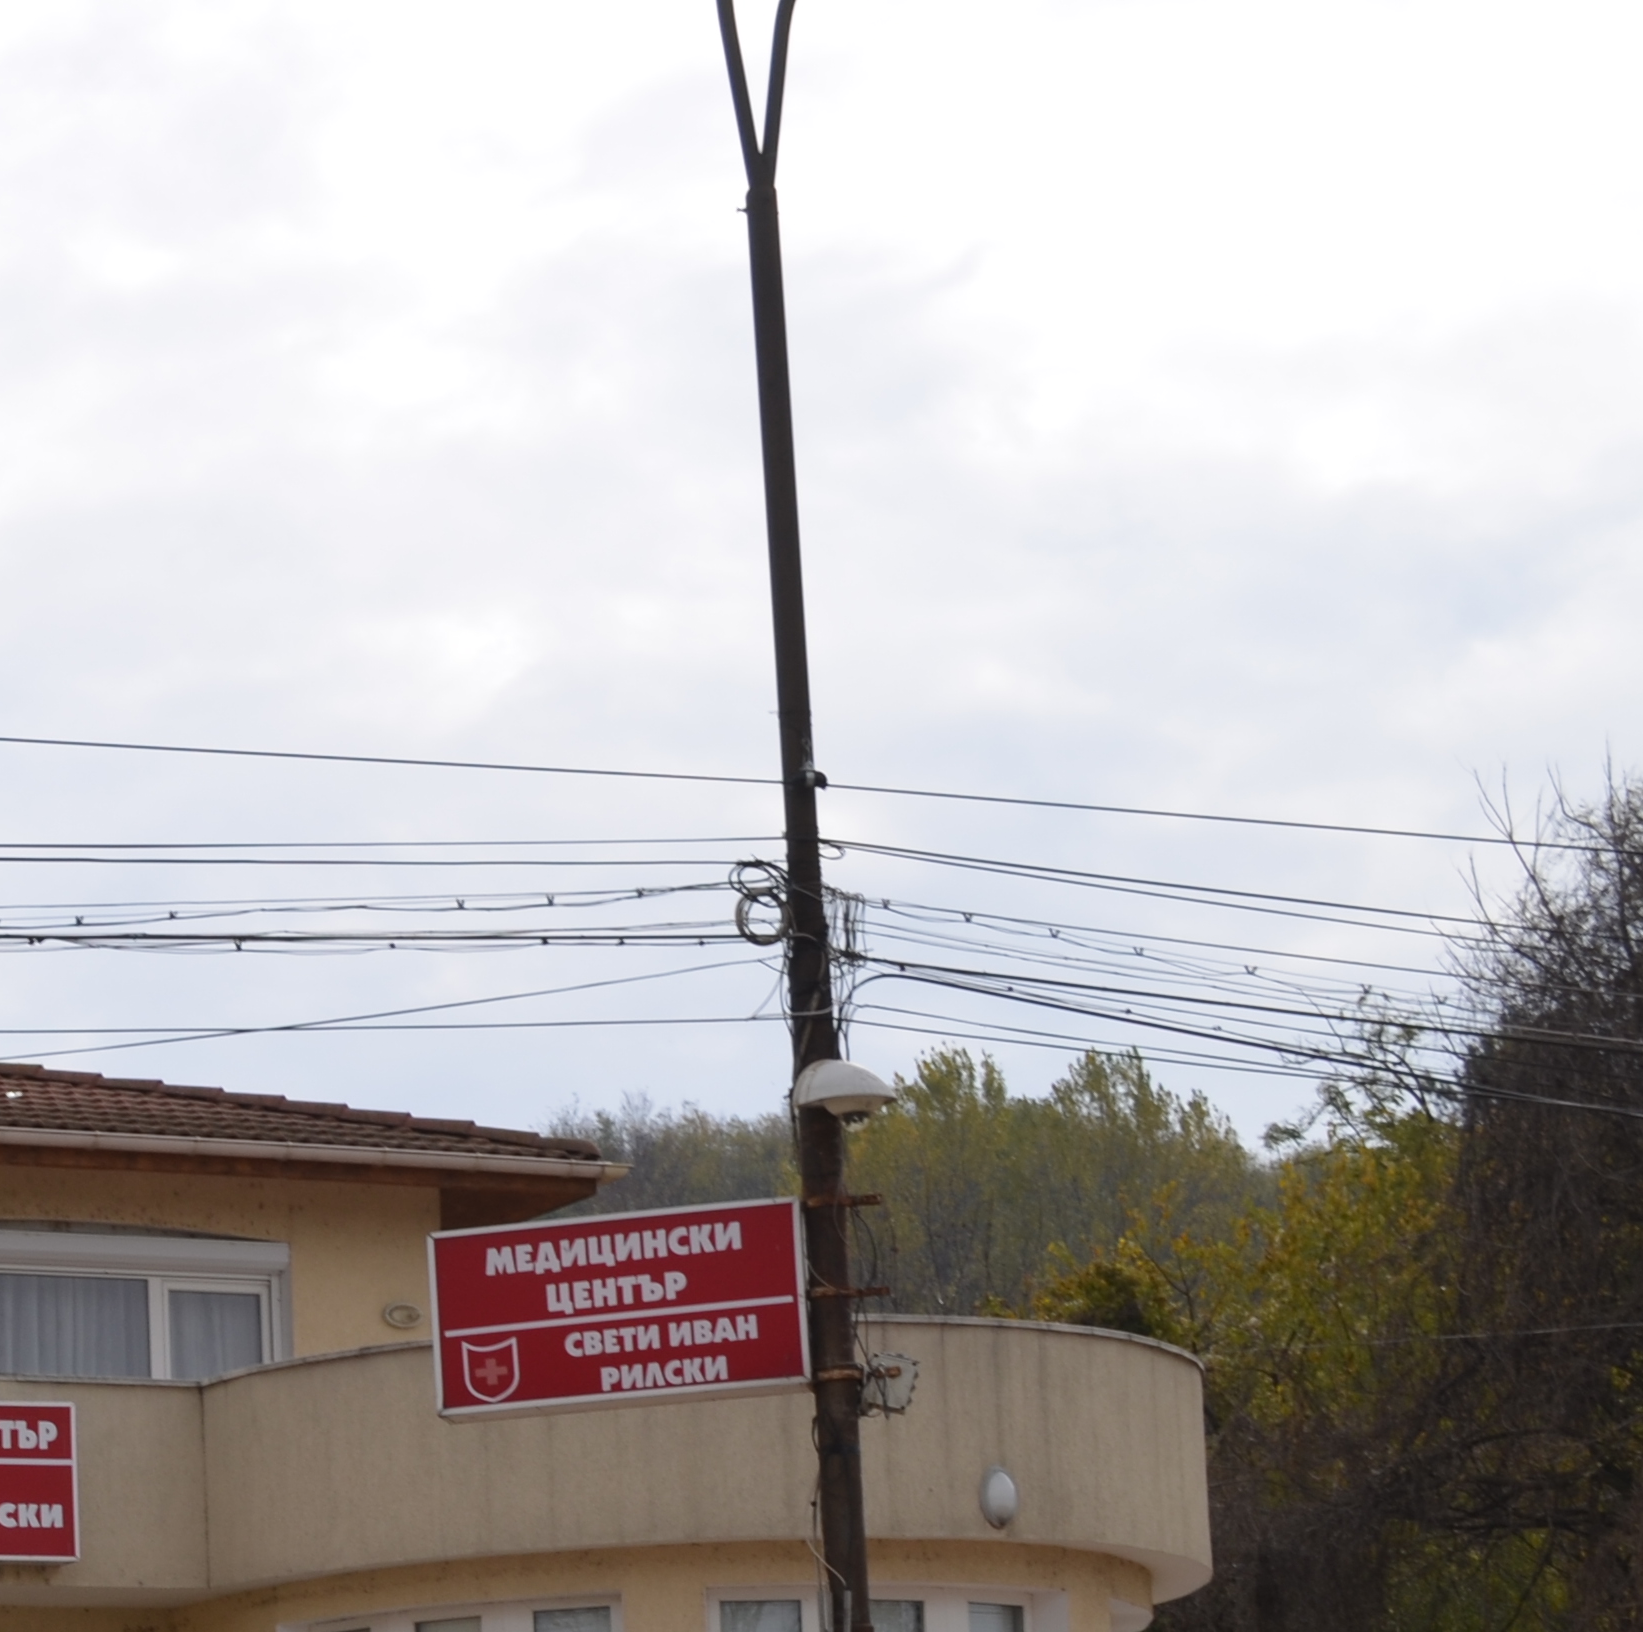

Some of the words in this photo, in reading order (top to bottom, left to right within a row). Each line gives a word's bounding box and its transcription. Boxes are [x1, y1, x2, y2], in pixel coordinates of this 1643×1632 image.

[485, 1220, 743, 1276] МЕДИЦИНСКИ
[545, 1270, 688, 1315] ЦЕНТЪР
[564, 1323, 661, 1357] СВЕТИ
[668, 1313, 759, 1348] ИВАН
[599, 1355, 729, 1392] РИЛСКИ
